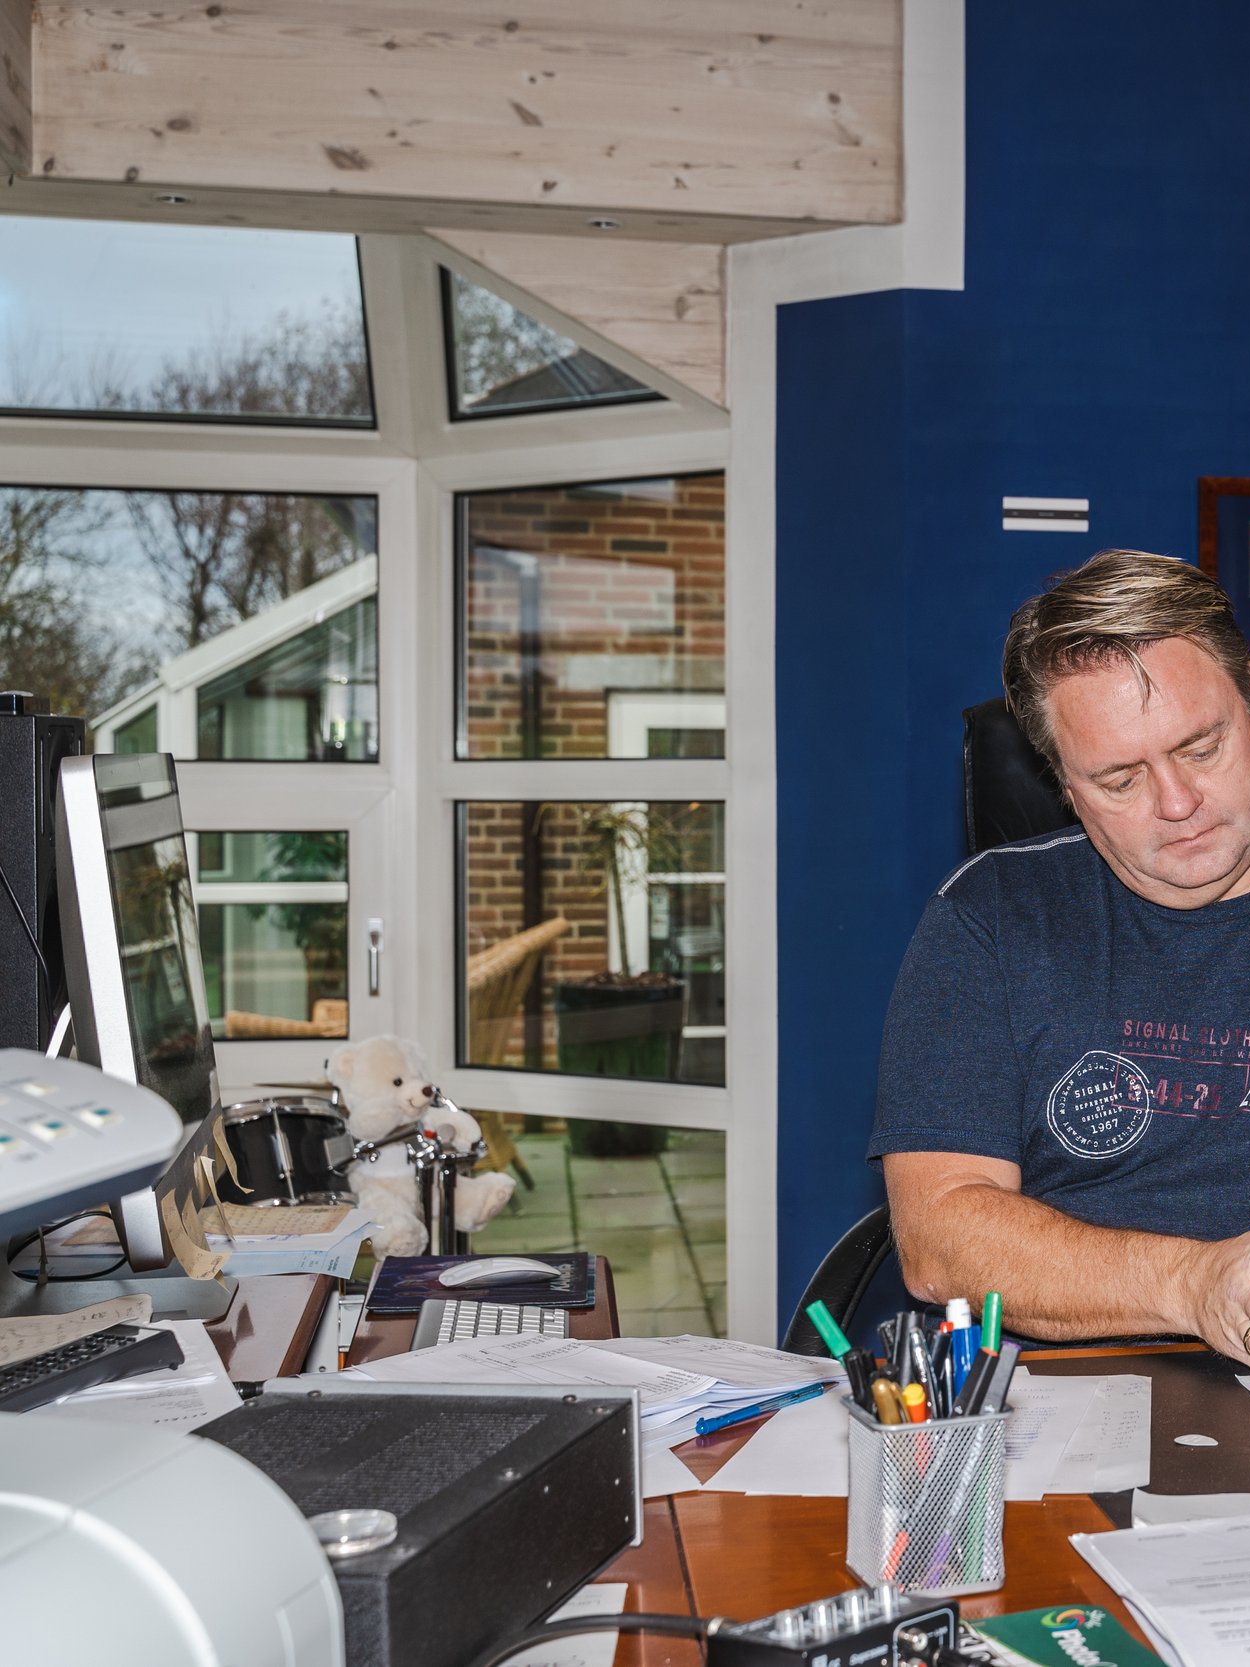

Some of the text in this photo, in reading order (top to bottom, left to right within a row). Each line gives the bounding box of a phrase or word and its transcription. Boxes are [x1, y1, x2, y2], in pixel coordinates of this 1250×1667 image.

[1122, 1019, 1190, 1042] SIGNAL
[1074, 1080, 1116, 1099] SIGNAL
[1074, 1092, 1123, 1111] DEPARTMENT
[1081, 1106, 1123, 1123] ORIGINALS
[1090, 1118, 1119, 1135] 1967
